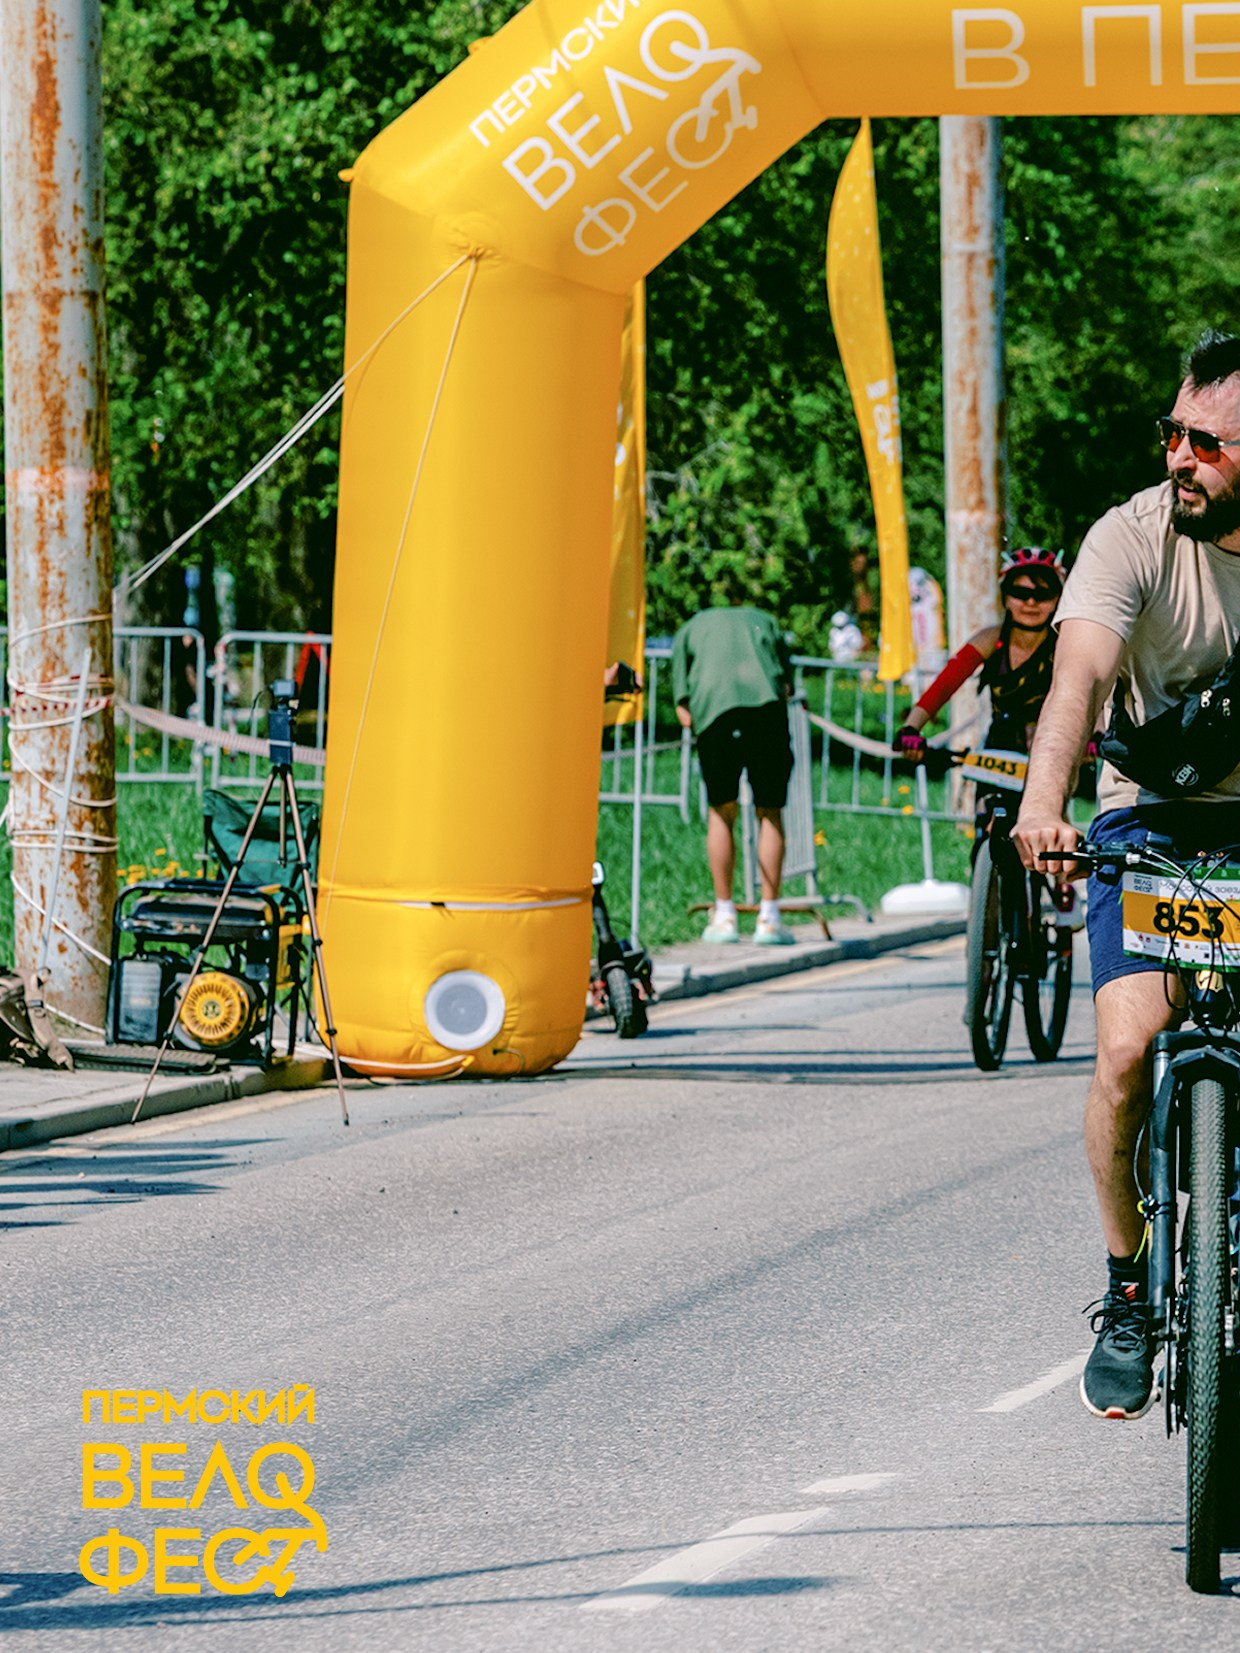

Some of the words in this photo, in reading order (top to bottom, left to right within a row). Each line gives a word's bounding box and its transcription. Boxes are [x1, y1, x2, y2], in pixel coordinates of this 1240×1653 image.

[468, 0, 640, 147] ПЕРМСКИ
[950, 8, 1031, 91] В
[976, 756, 1017, 776] 1043
[1153, 901, 1225, 939] 853
